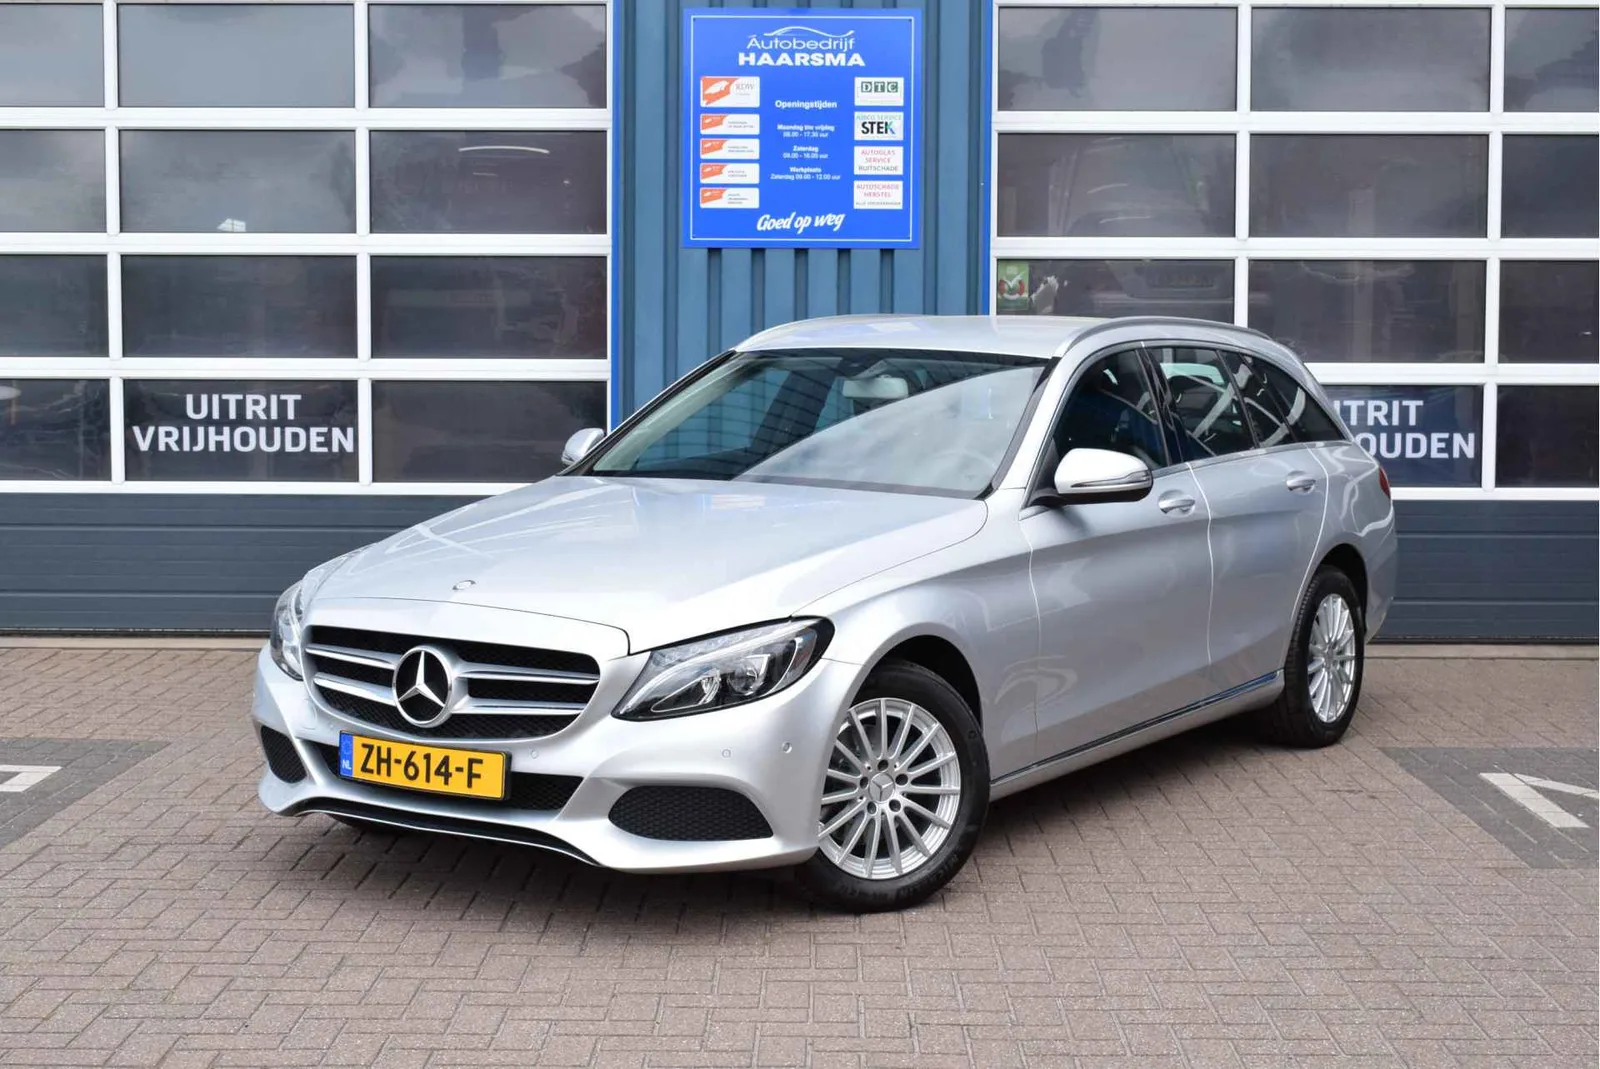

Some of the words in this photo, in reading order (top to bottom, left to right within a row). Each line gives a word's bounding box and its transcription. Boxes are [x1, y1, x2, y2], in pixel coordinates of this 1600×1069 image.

[747, 36, 855, 52] Autobedrijf
[738, 53, 866, 67] HAARSMA
[862, 81, 898, 93] DTC
[775, 99, 838, 110] Openingstijden
[777, 123, 804, 131] Maandag
[861, 121, 896, 135] STEK
[789, 166, 822, 174] Werkplaats
[756, 212, 796, 231] Goed
[794, 216, 812, 234] op
[814, 212, 846, 231] weg
[185, 394, 302, 420] UITRIT
[132, 426, 355, 453] VRIJHOUDEN
[342, 759, 353, 771] NL
[360, 742, 484, 789] ZH-614-F
